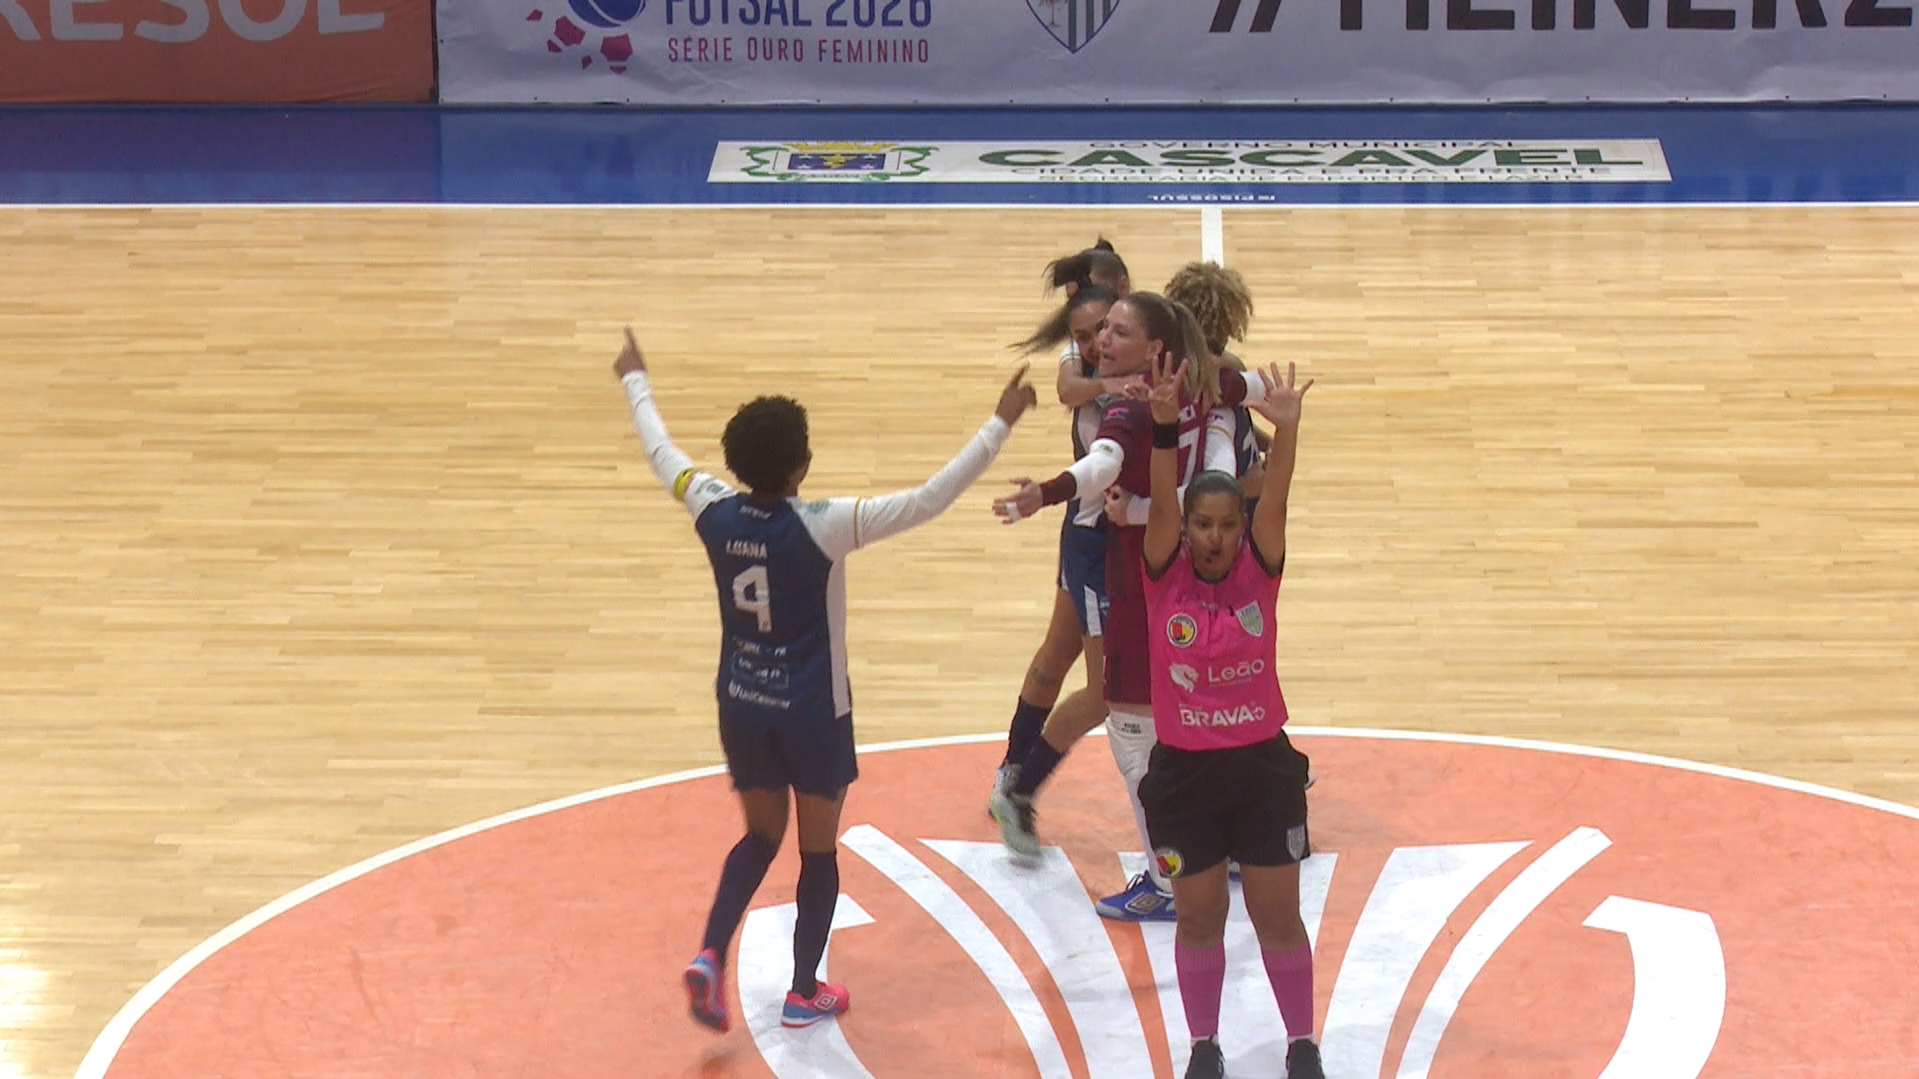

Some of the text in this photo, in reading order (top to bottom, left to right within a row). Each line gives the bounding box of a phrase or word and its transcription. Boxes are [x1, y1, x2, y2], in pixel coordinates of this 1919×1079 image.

[747, 36, 804, 62] OURO
[818, 39, 929, 63] FEMININO
[1090, 140, 1530, 149] GOVERNO MUNICIPAL
[978, 148, 1644, 167] CASCAVEL
[726, 539, 768, 559] LUANA
[732, 564, 772, 633] 9
[1207, 658, 1265, 683] Leão
[1179, 705, 1255, 727] BRAVA
